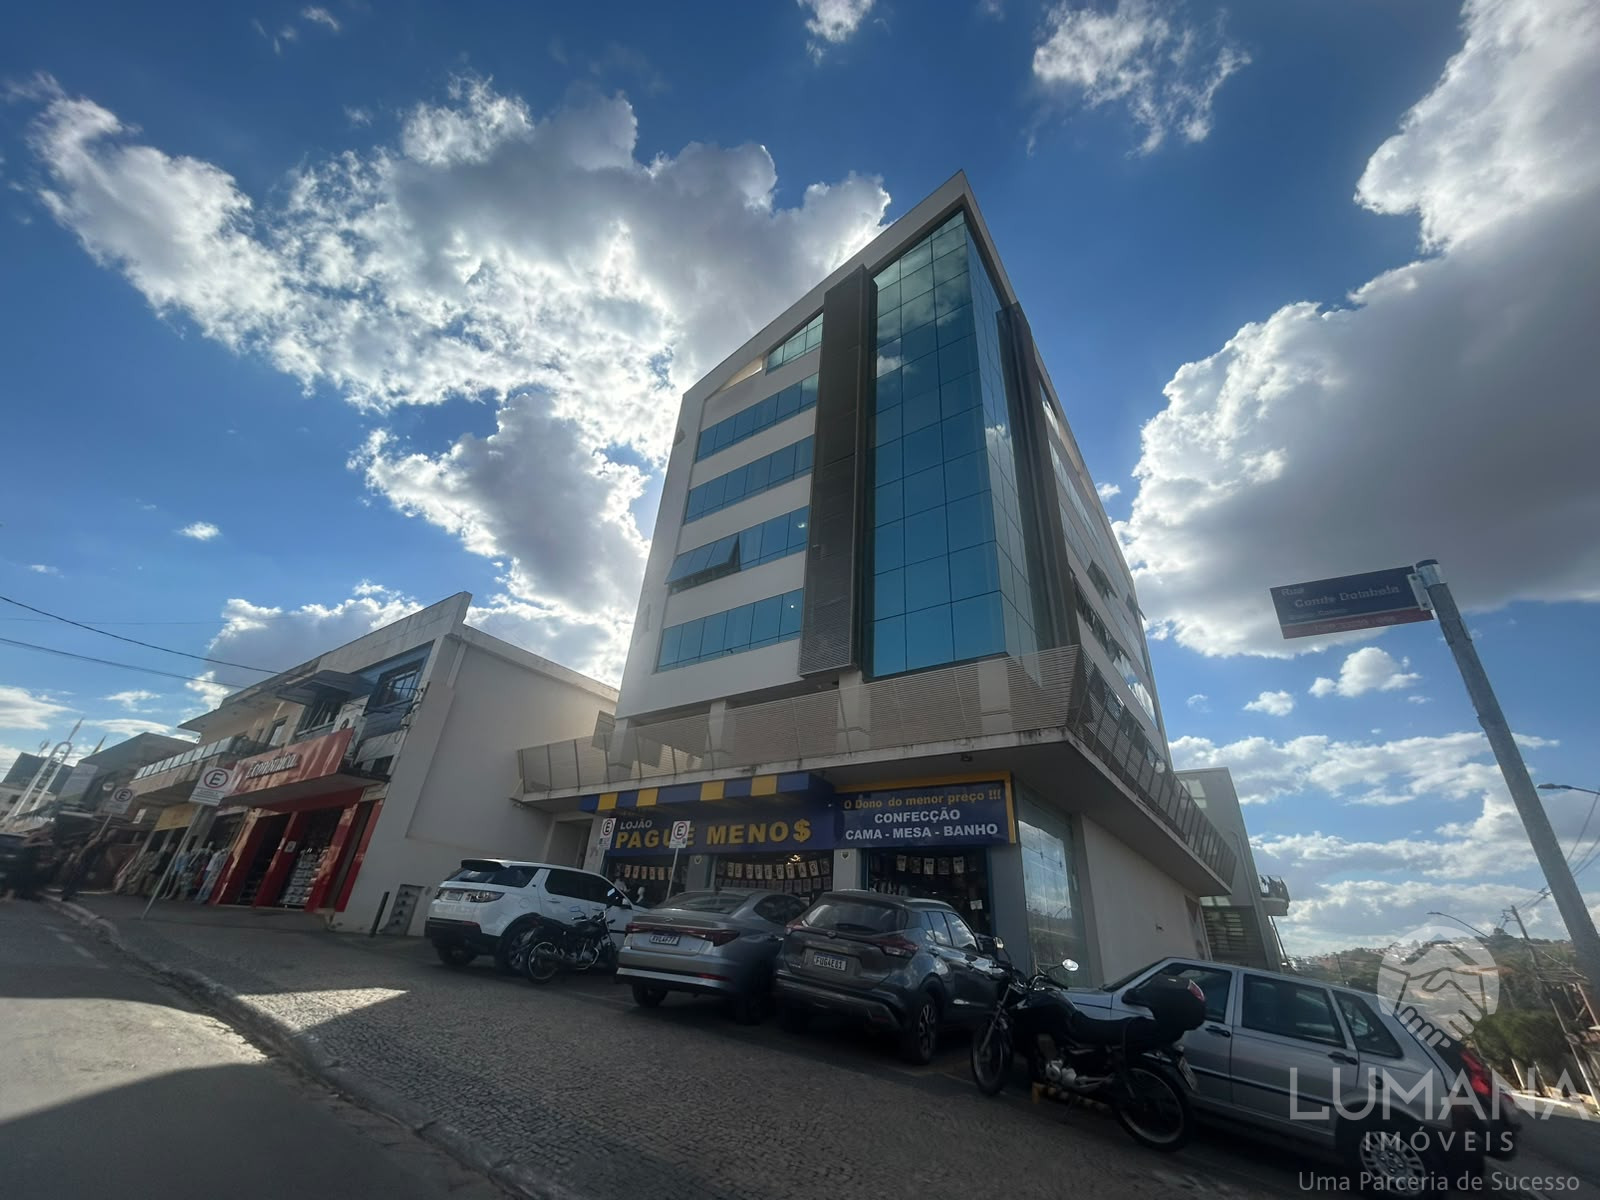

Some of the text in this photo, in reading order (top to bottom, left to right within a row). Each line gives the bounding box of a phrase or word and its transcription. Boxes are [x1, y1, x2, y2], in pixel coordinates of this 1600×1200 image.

[1281, 588, 1304, 596] Rua
[209, 772, 223, 785] E
[844, 800, 852, 810] O
[855, 799, 883, 809] Dono
[888, 796, 902, 807] do
[905, 793, 944, 806] menor
[947, 790, 985, 805] preço
[874, 807, 961, 824] CONFECÇÃO
[620, 818, 653, 830] LOJÃO
[845, 828, 883, 840] CAMA
[893, 826, 932, 839] MESA
[943, 823, 998, 837] BANHO
